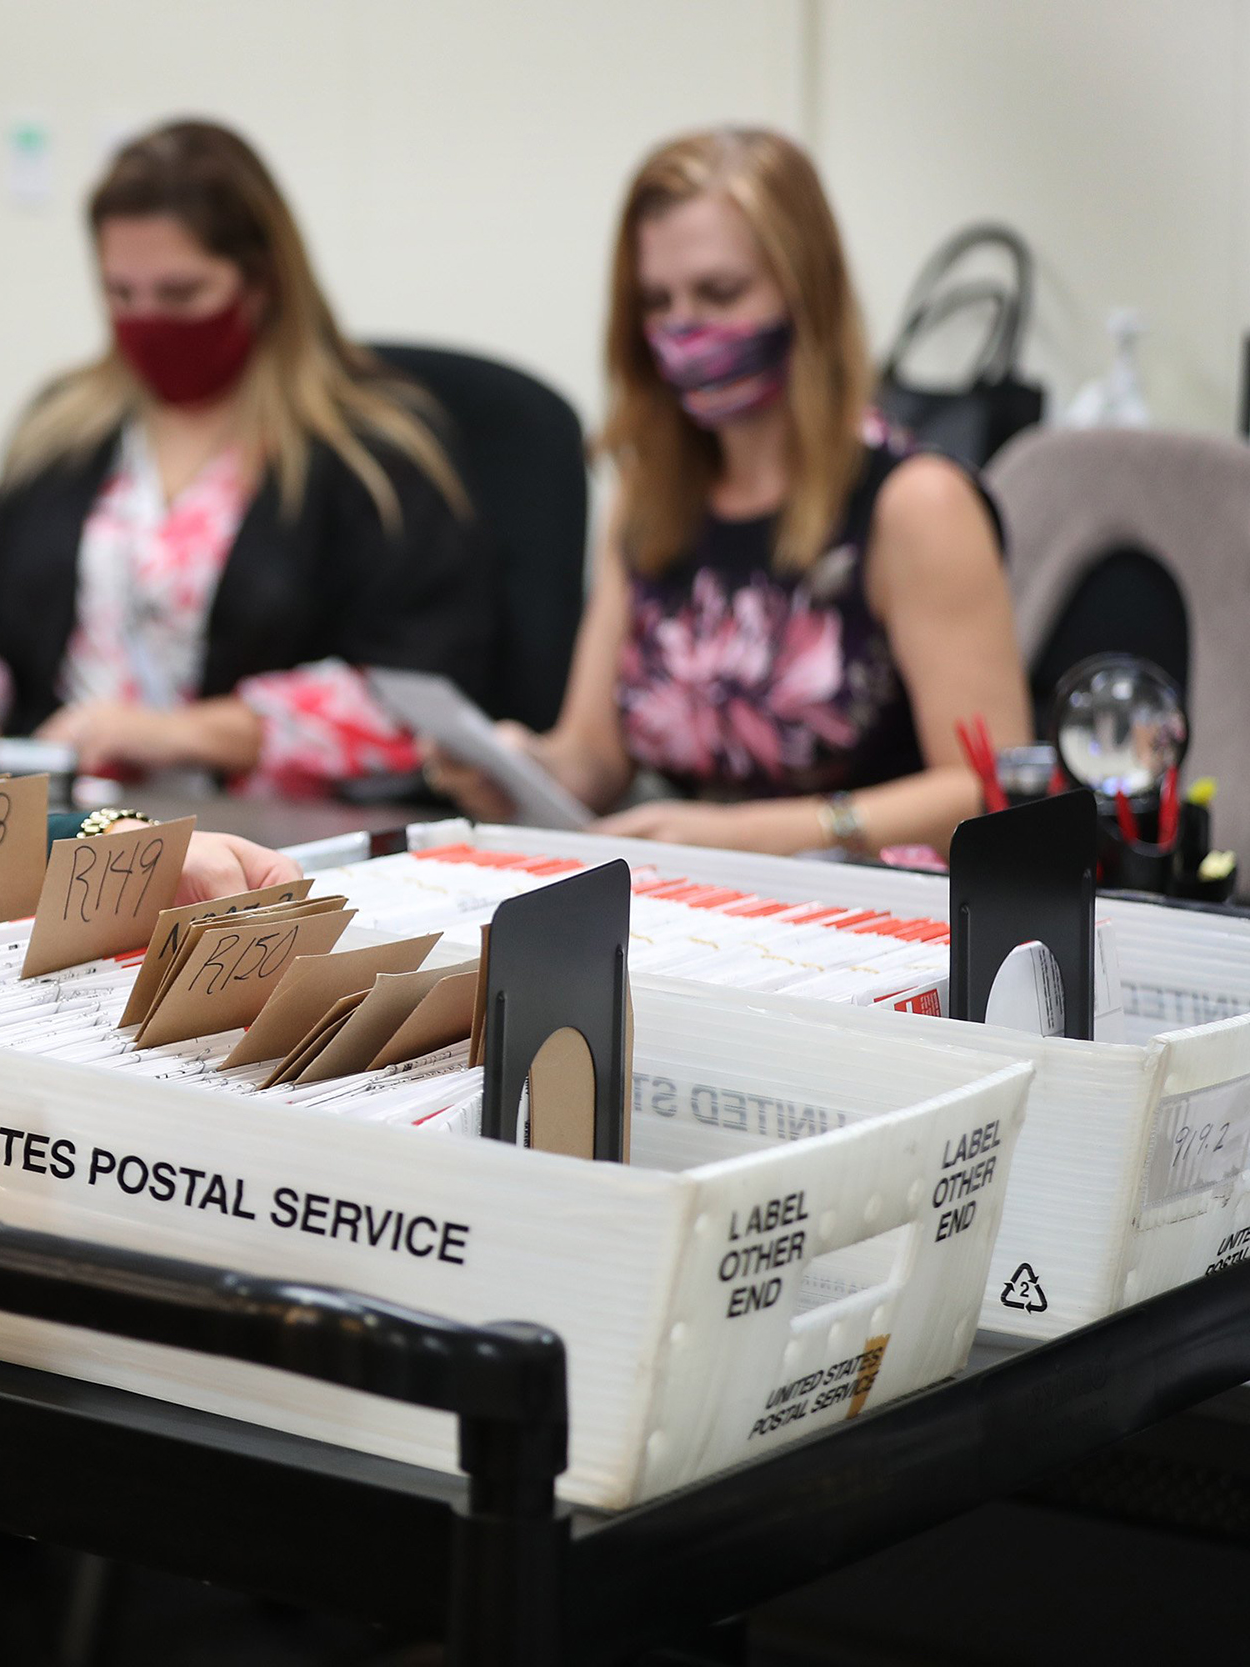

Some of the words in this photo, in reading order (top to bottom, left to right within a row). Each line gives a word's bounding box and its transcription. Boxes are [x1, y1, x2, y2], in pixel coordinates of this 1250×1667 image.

[63, 838, 164, 922] R149
[188, 924, 299, 995] R150
[941, 1119, 1000, 1169] LABEL
[88, 1147, 256, 1220] POSTAL
[269, 1187, 470, 1265] SERVICE
[932, 1156, 996, 1208] OTHER
[728, 1190, 808, 1241] LABEL
[934, 1200, 976, 1243] END
[719, 1231, 805, 1281] OTHER
[726, 1278, 782, 1319] END
[1020, 1282, 1029, 1298] 2
[765, 1369, 824, 1409] UNITED
[824, 1346, 883, 1386] STATES
[748, 1402, 807, 1440] POSTAL
[810, 1370, 880, 1413] SERVICE
